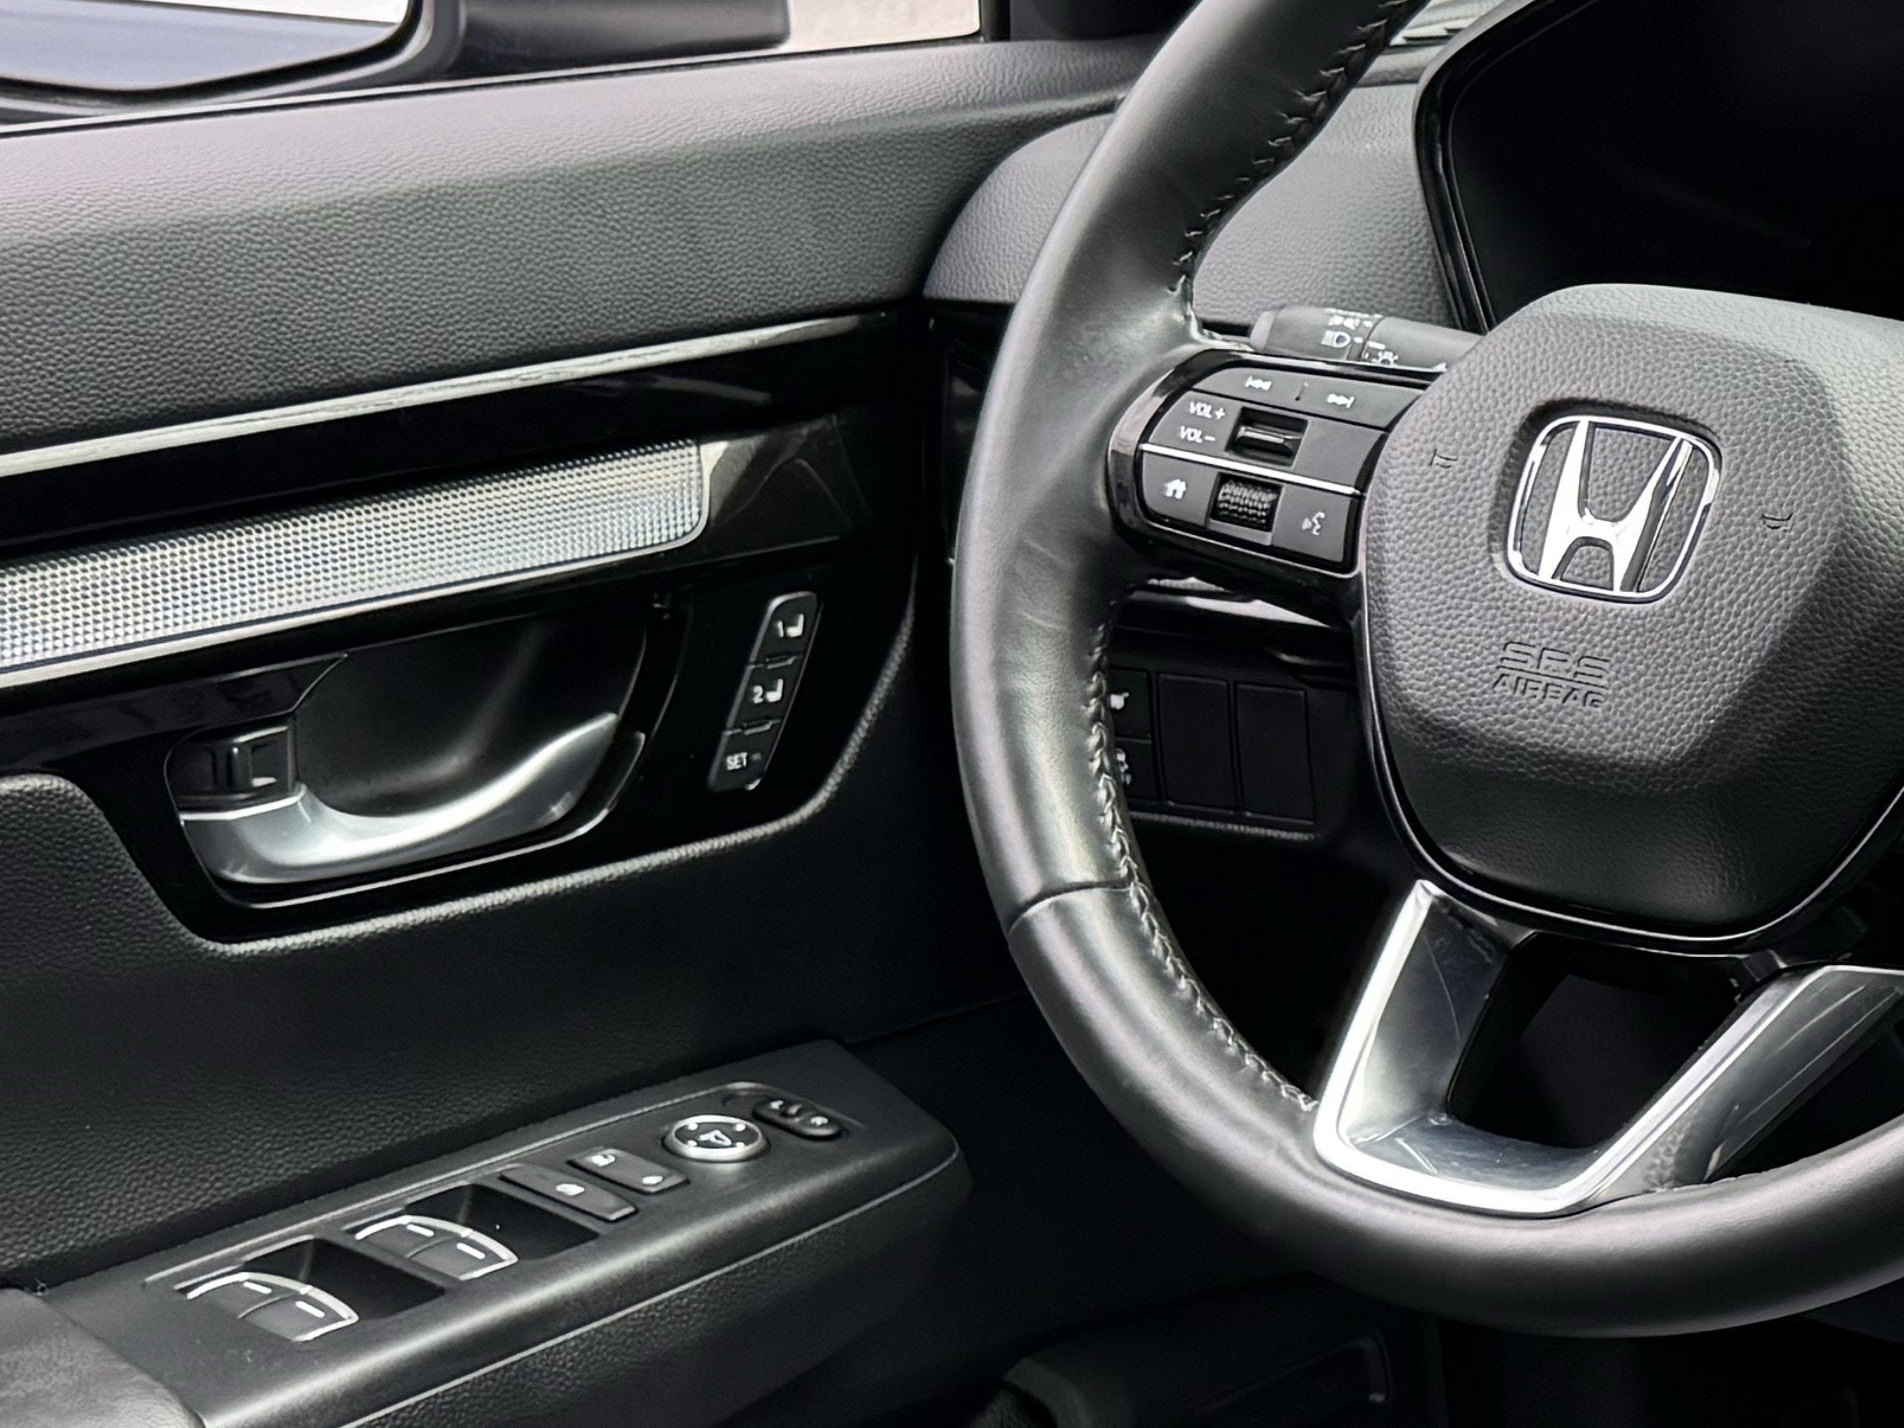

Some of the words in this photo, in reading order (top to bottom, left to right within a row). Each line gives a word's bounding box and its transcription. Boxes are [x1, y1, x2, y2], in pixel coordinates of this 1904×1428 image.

[776, 620, 784, 638] 1
[752, 684, 764, 704] 2
[1493, 671, 1607, 708] AIRBAG
[726, 752, 747, 771] SET
